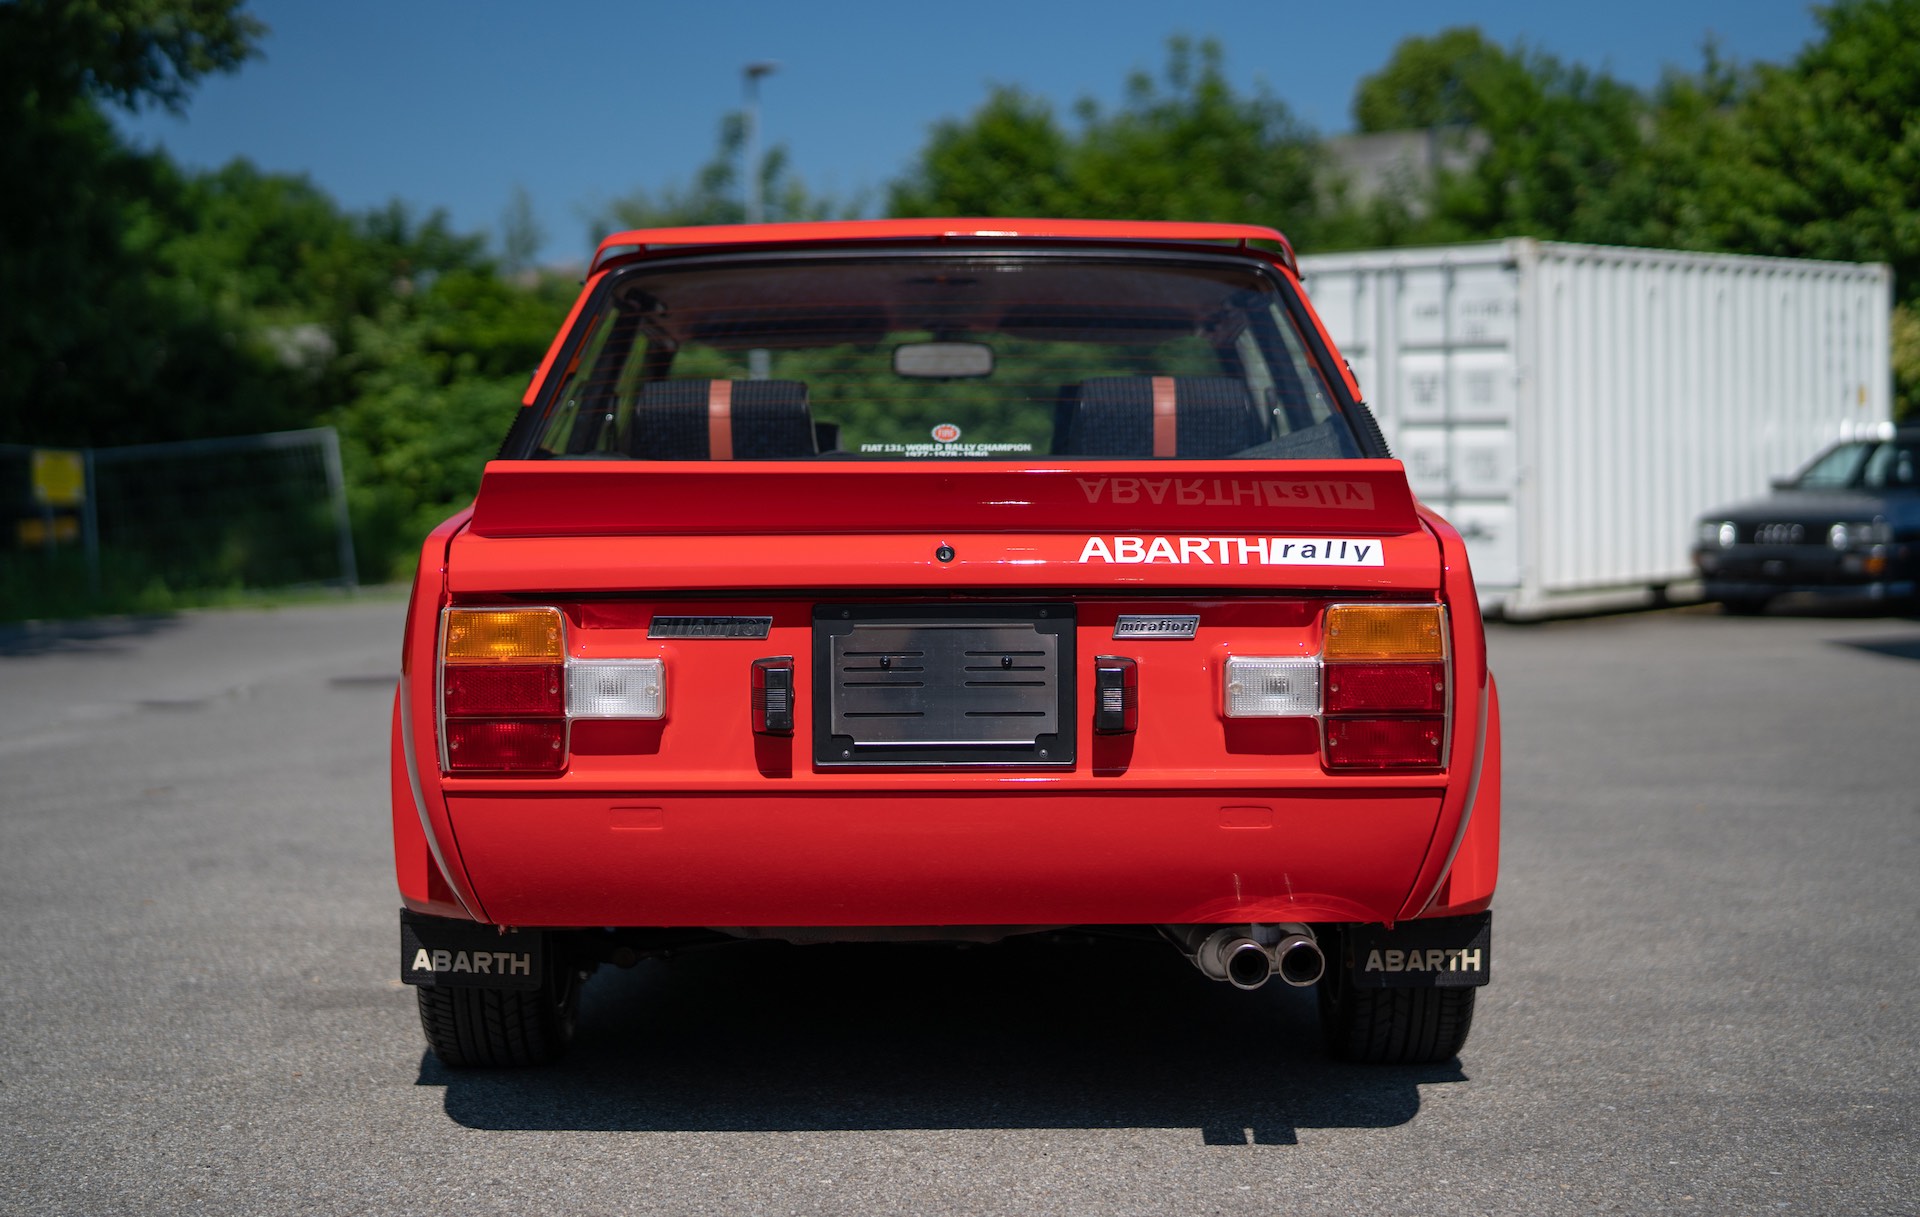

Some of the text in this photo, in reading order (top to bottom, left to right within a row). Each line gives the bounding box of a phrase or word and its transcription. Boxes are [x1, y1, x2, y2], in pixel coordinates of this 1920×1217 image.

[861, 443, 884, 452] FIAT
[905, 443, 943, 452] WORLD
[945, 443, 977, 452] RALLY
[977, 443, 1032, 452] CHAMPION
[1078, 536, 1371, 565] ABARTH rally
[1120, 620, 1194, 631] mirafiori
[411, 948, 531, 976] ABARTH
[1364, 948, 1481, 972] ABARTH
